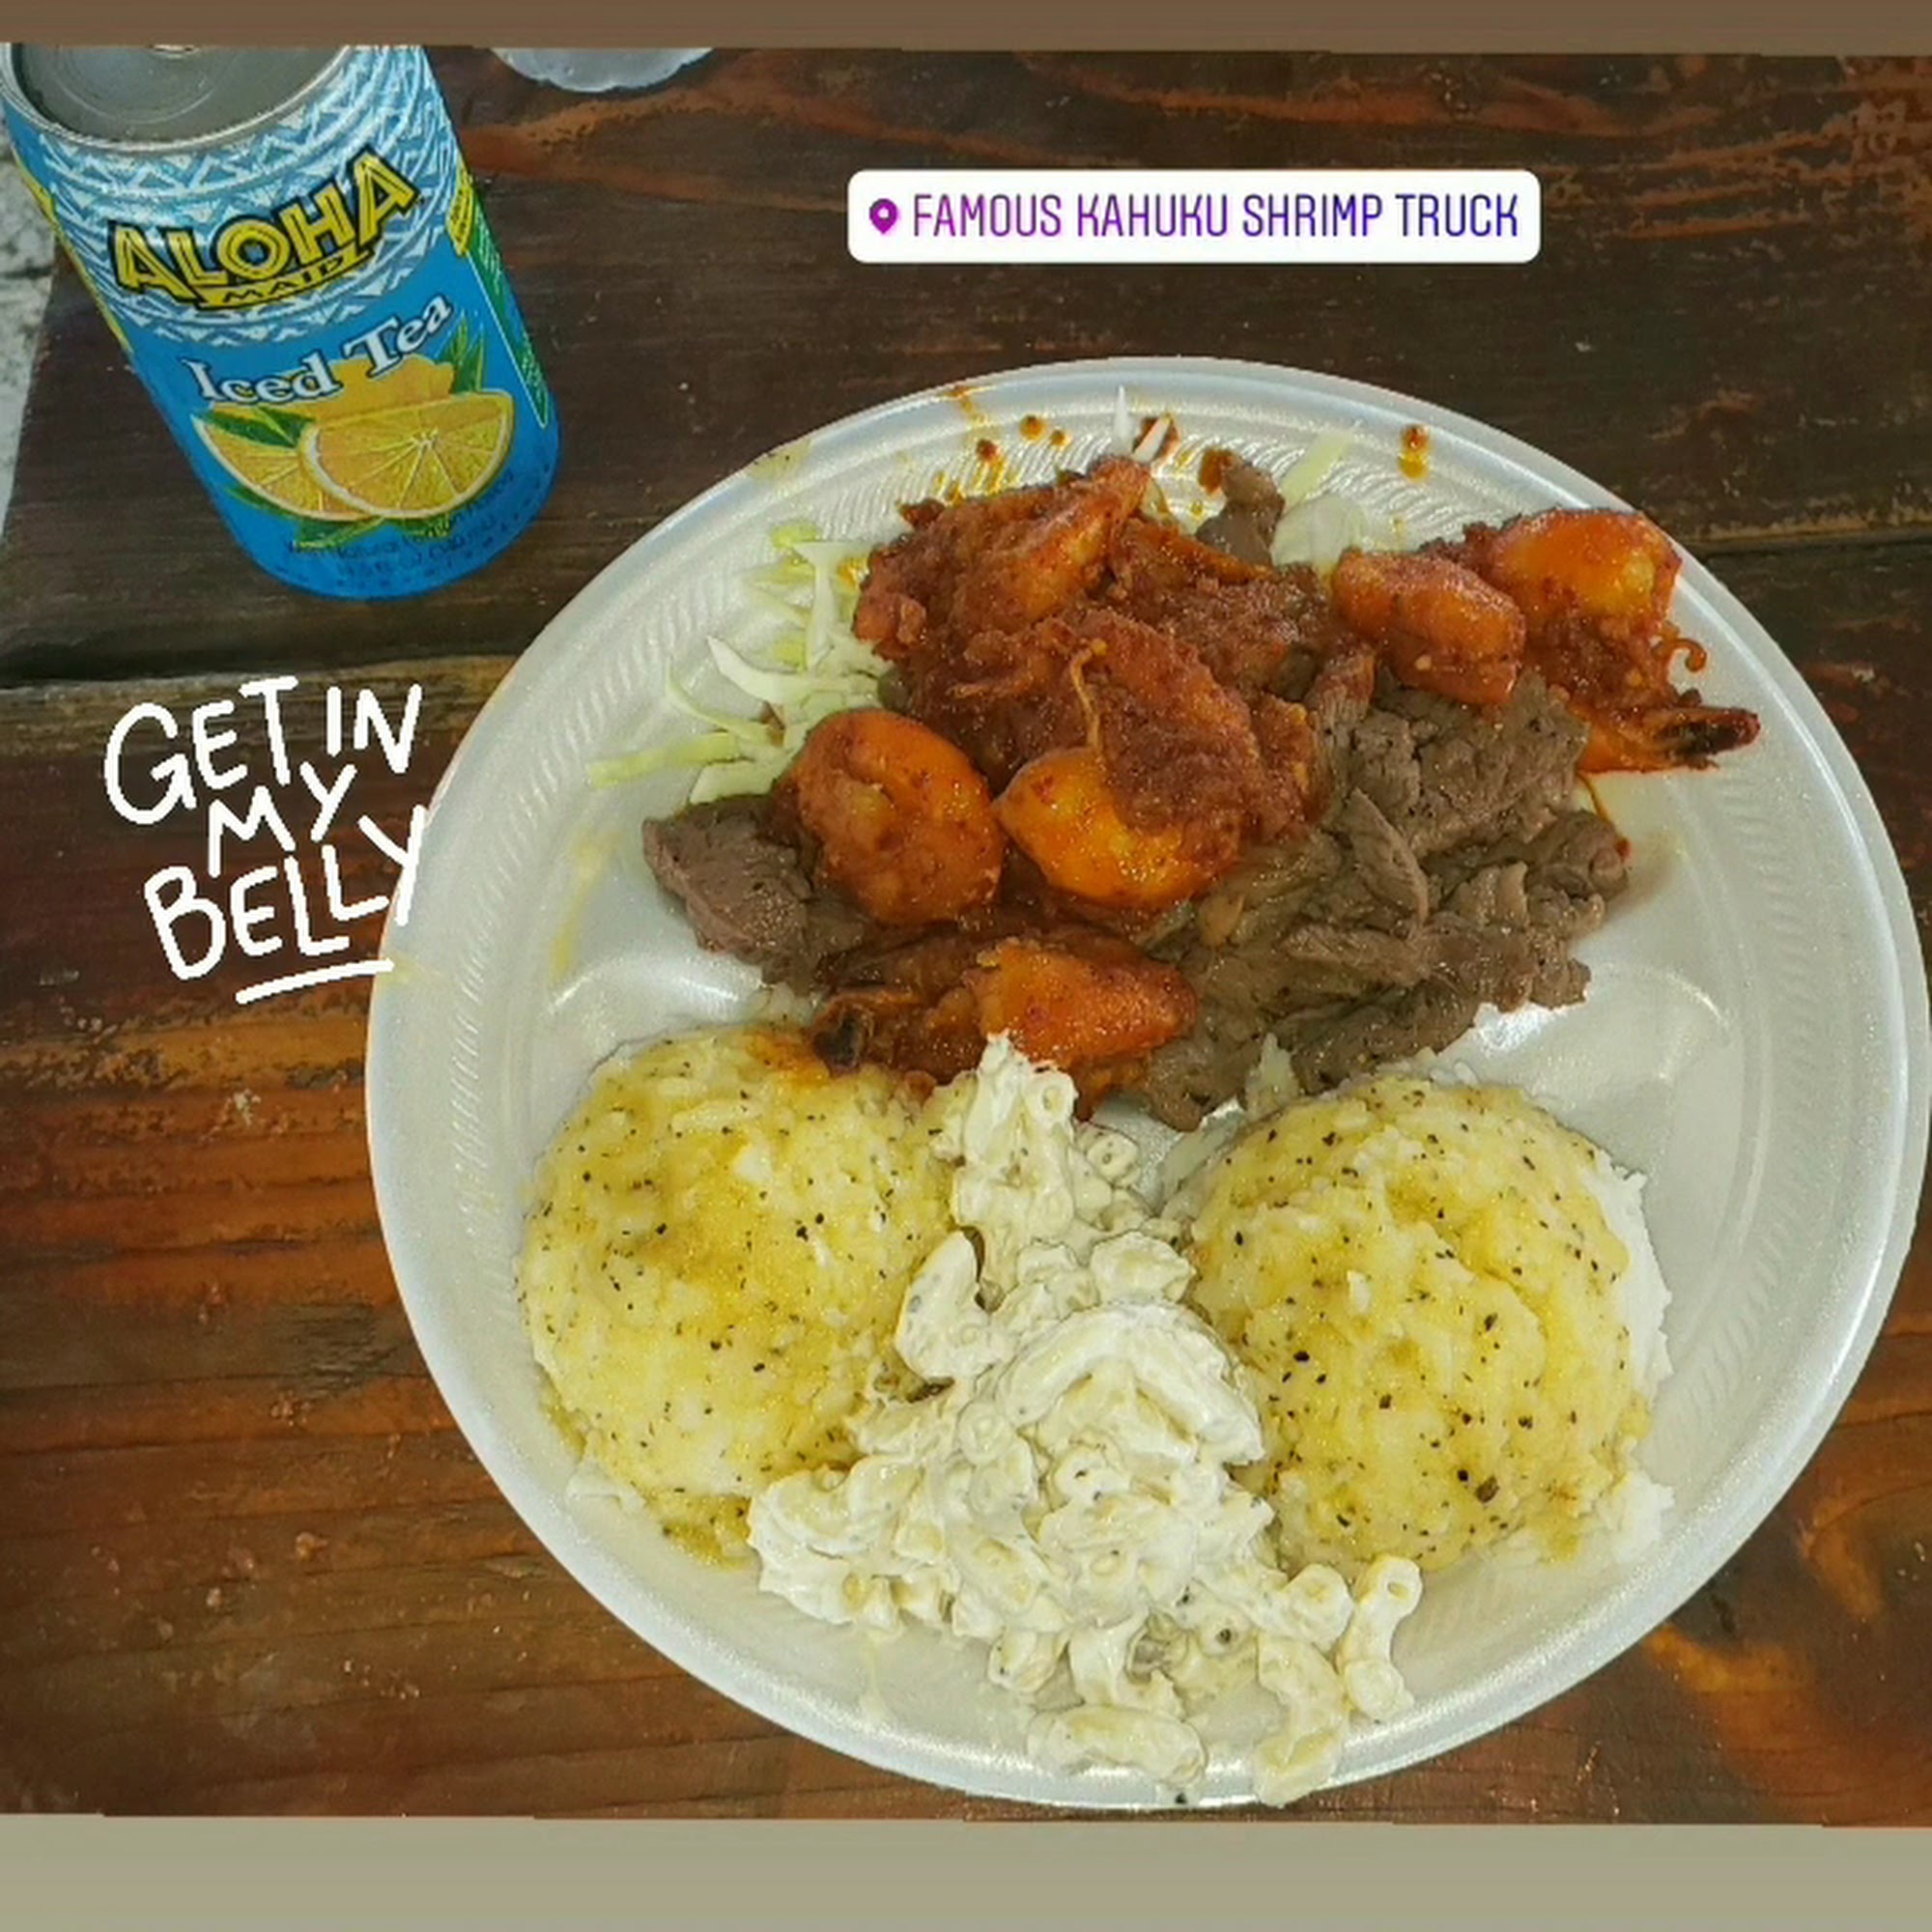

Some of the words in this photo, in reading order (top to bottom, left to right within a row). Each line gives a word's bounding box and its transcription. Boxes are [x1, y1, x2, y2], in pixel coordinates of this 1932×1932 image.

[109, 148, 419, 303] ALOHA
[223, 253, 346, 303] MAID
[181, 350, 343, 405] Iced
[342, 295, 454, 379] Tea
